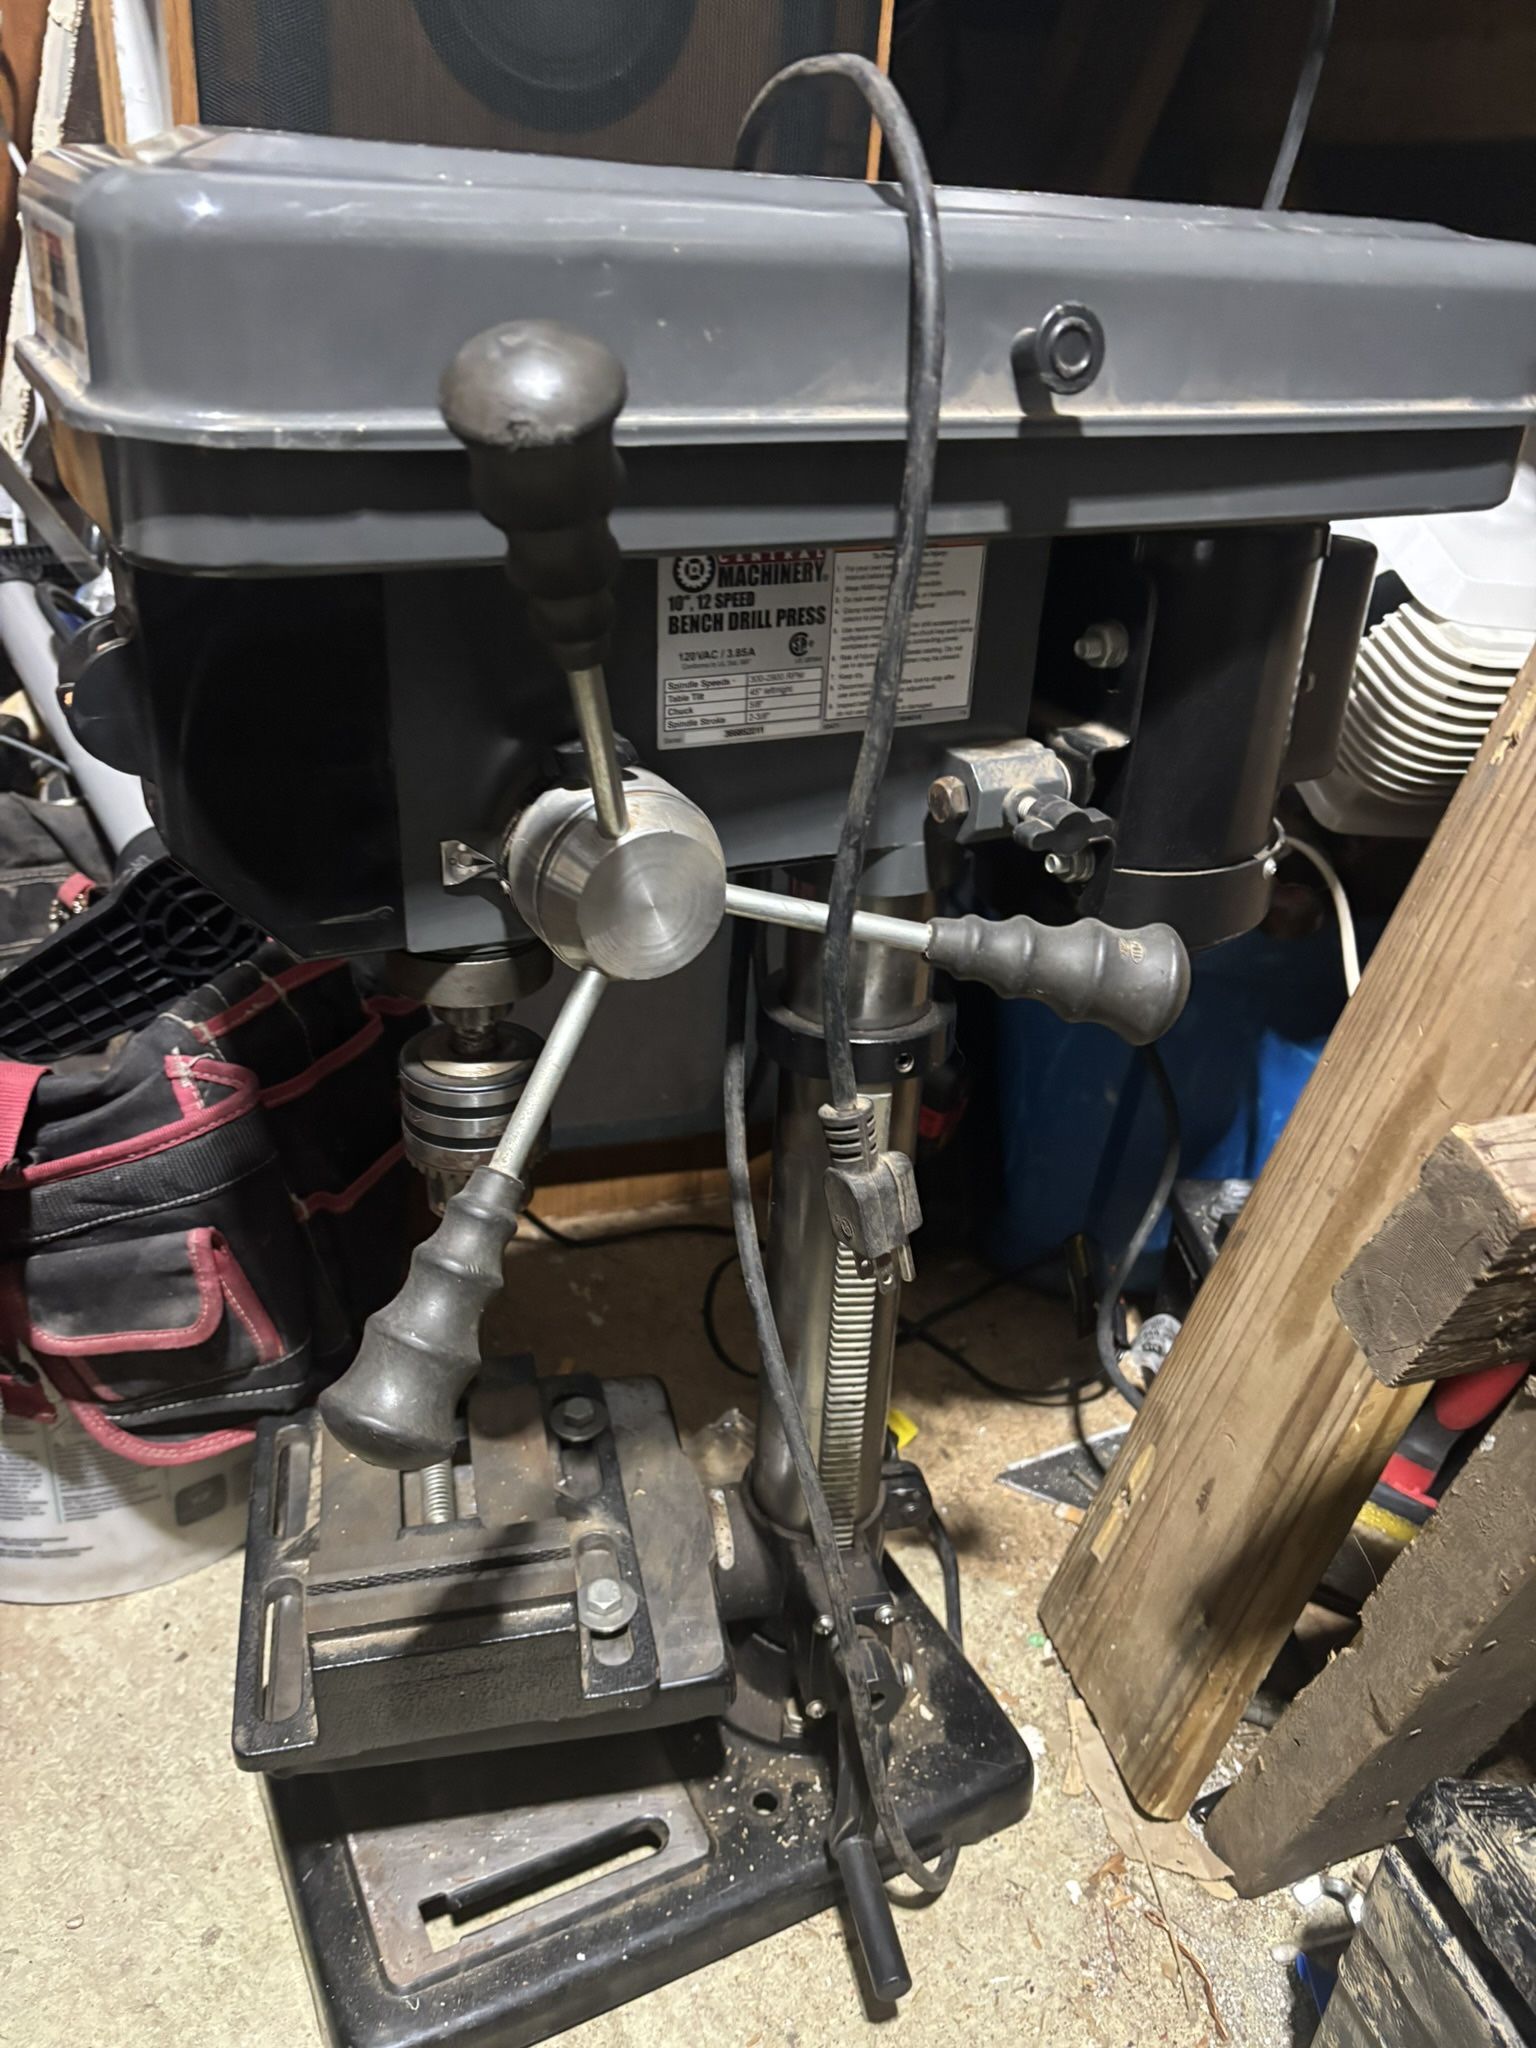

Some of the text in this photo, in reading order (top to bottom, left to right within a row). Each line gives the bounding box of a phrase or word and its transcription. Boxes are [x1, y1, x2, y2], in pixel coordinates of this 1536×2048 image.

[717, 561, 825, 588] MACHINERY
[697, 593, 712, 610] 12
[715, 591, 755, 609] SPEED
[667, 605, 826, 635] BENCH DRILL PRESS
[667, 680, 698, 691] Spindle
